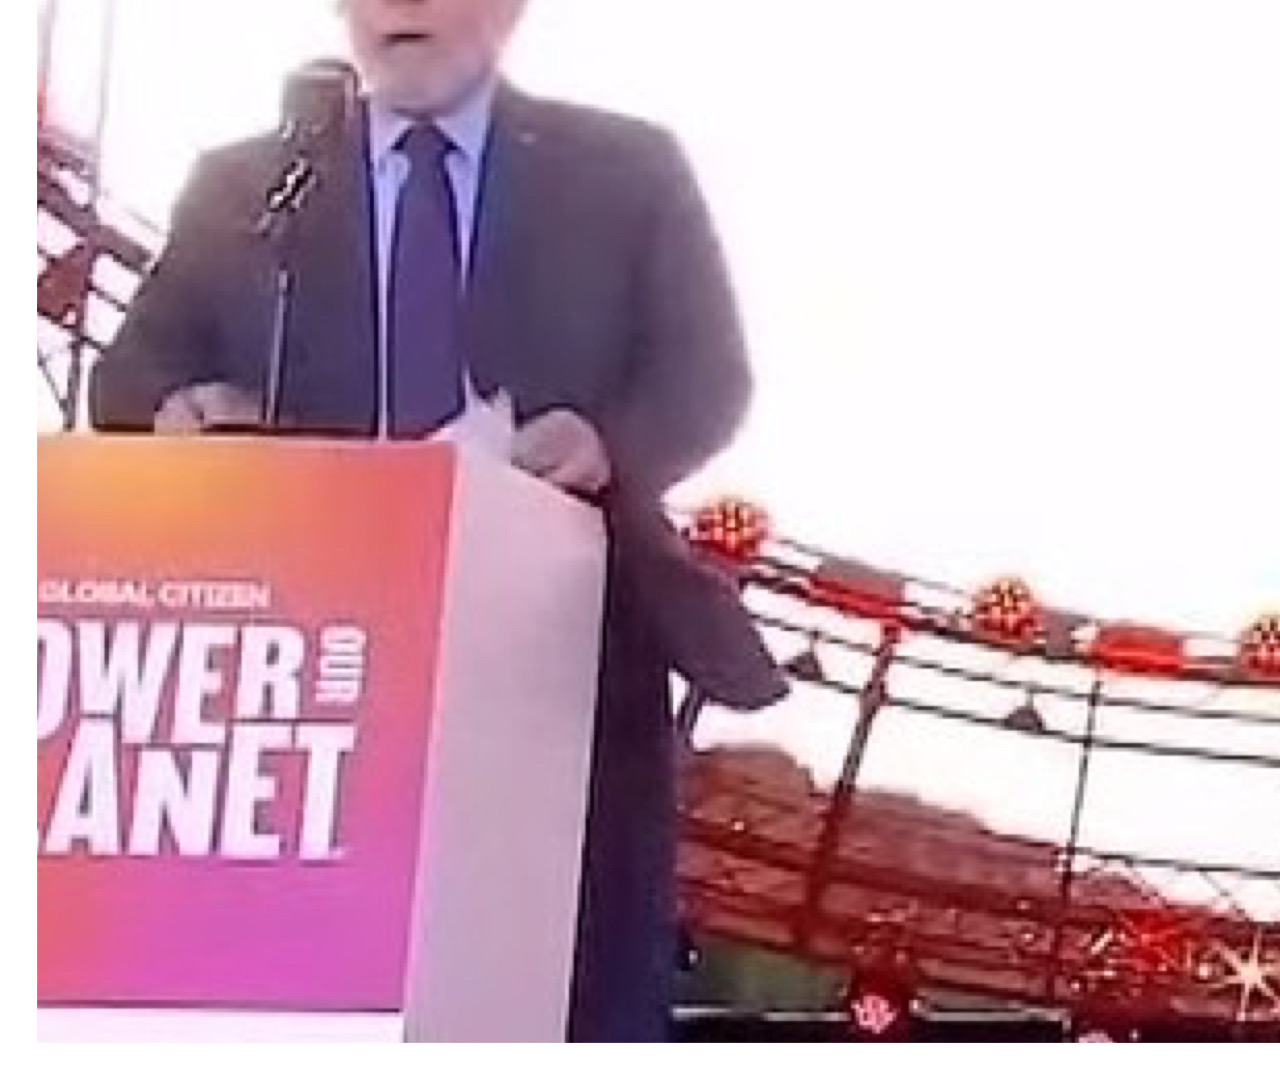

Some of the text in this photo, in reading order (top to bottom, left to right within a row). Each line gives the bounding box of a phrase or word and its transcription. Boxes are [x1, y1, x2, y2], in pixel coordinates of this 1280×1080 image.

[38, 580, 271, 608] GLOBAL CITIZEN
[314, 625, 366, 703] OUR
[37, 719, 355, 860] ANET
